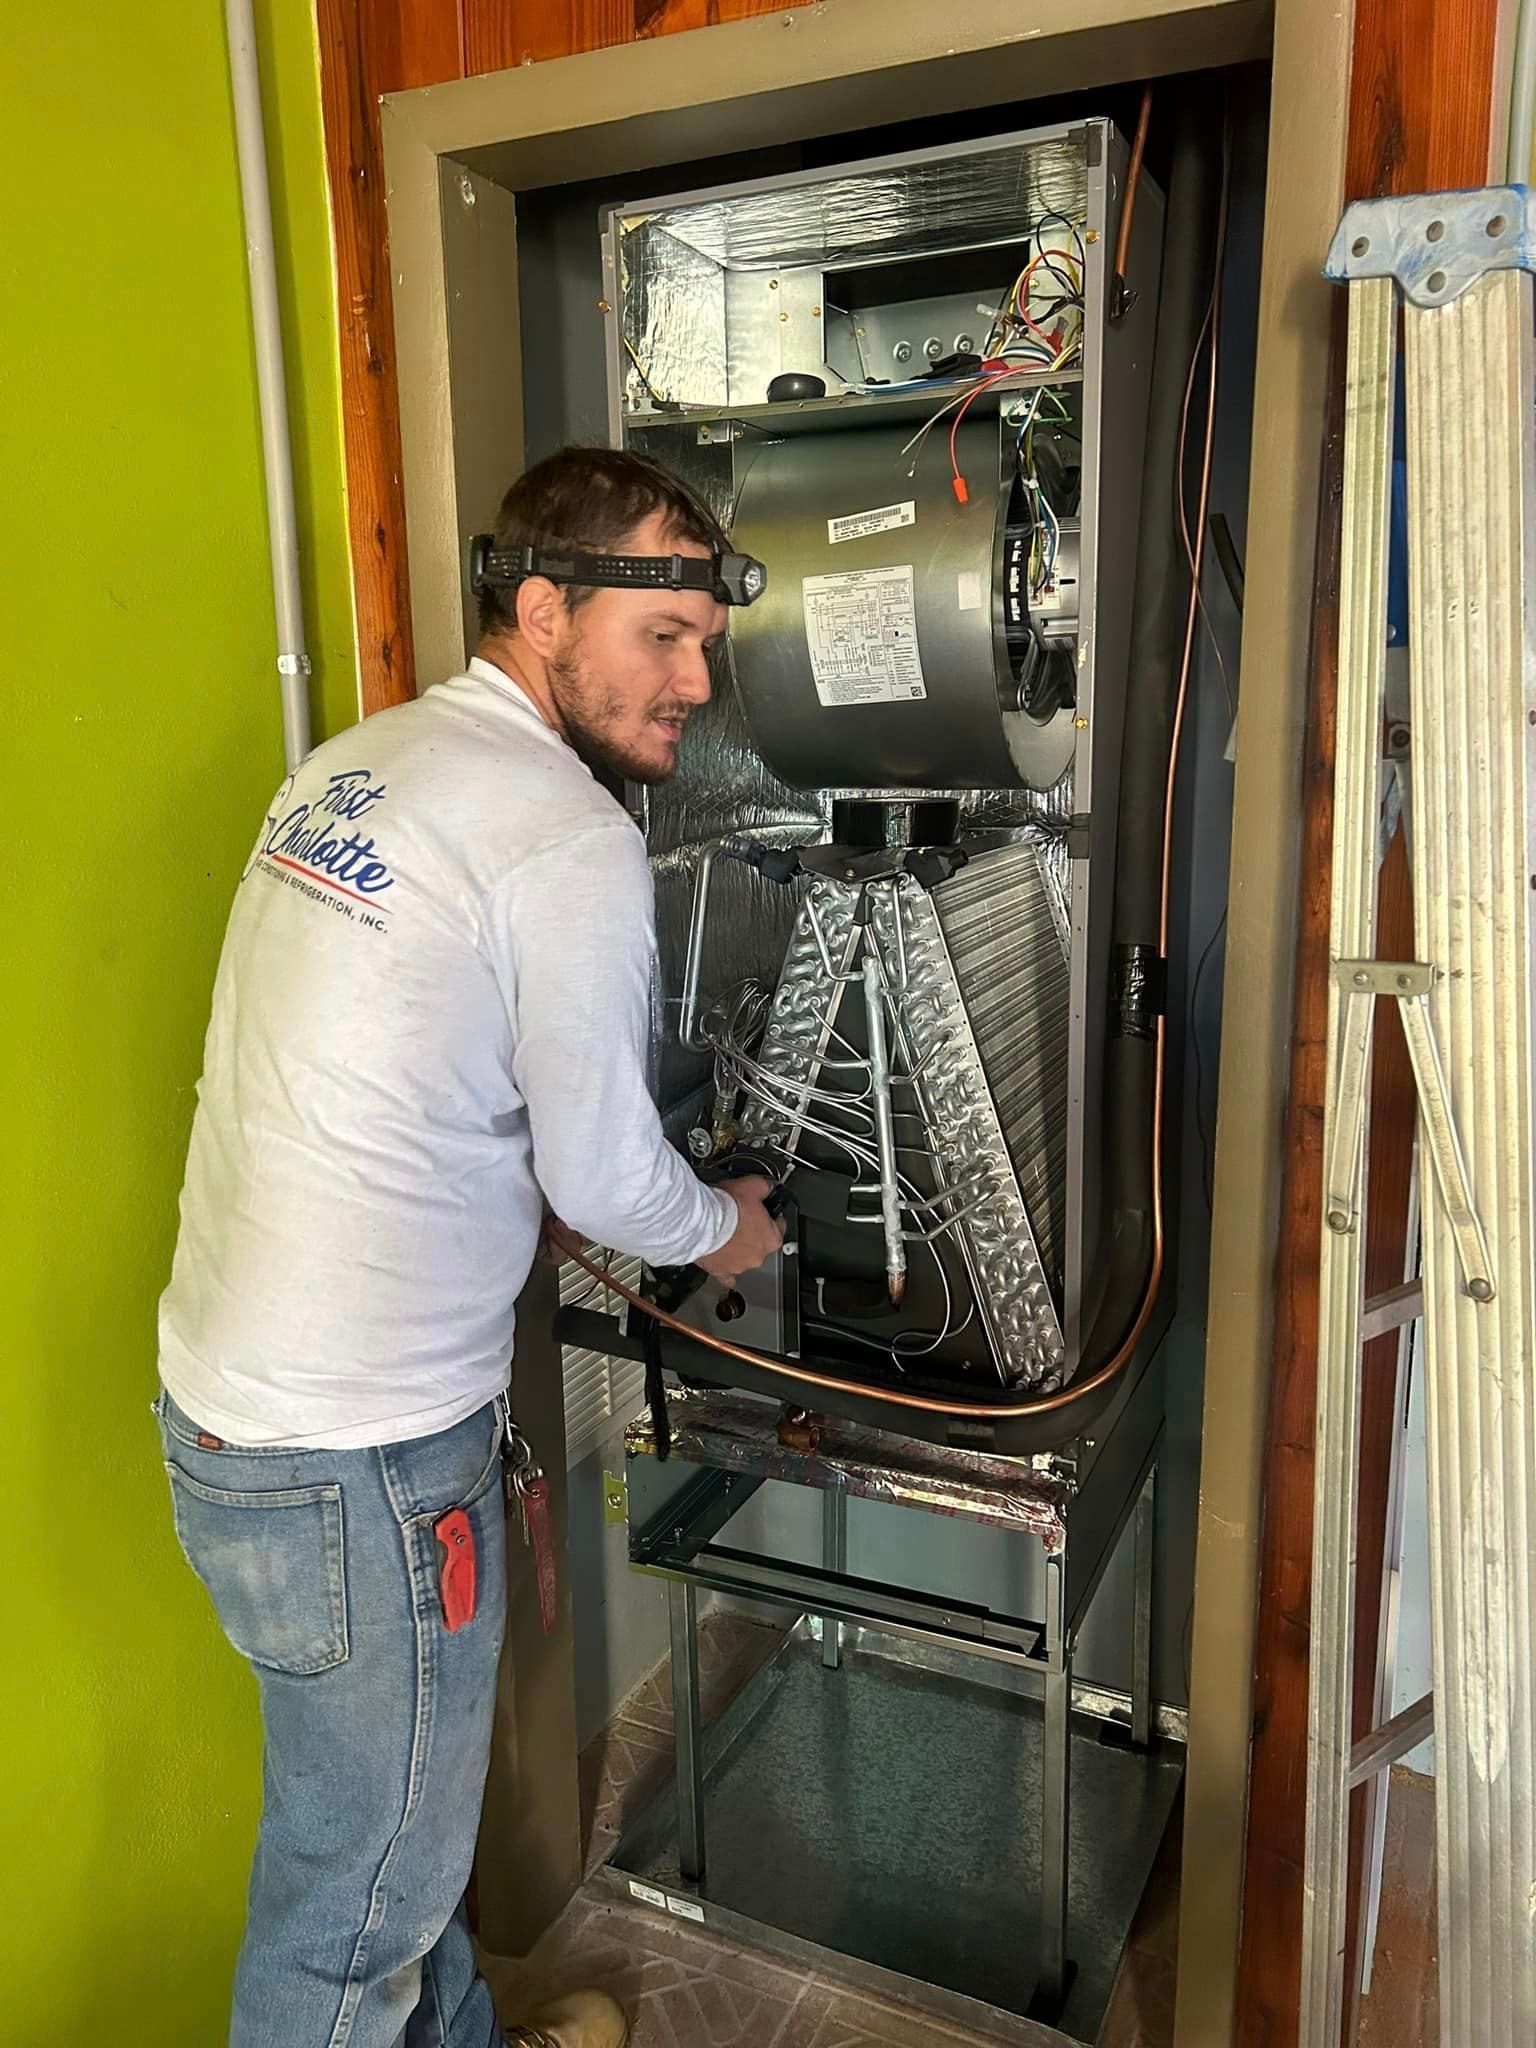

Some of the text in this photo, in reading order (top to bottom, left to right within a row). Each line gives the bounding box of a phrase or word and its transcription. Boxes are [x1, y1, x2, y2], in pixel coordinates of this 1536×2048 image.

[312, 770, 386, 821] First
[266, 804, 394, 892] Charlotte
[290, 876, 356, 921] REFRIGERATION,
[359, 912, 388, 934] INC.
